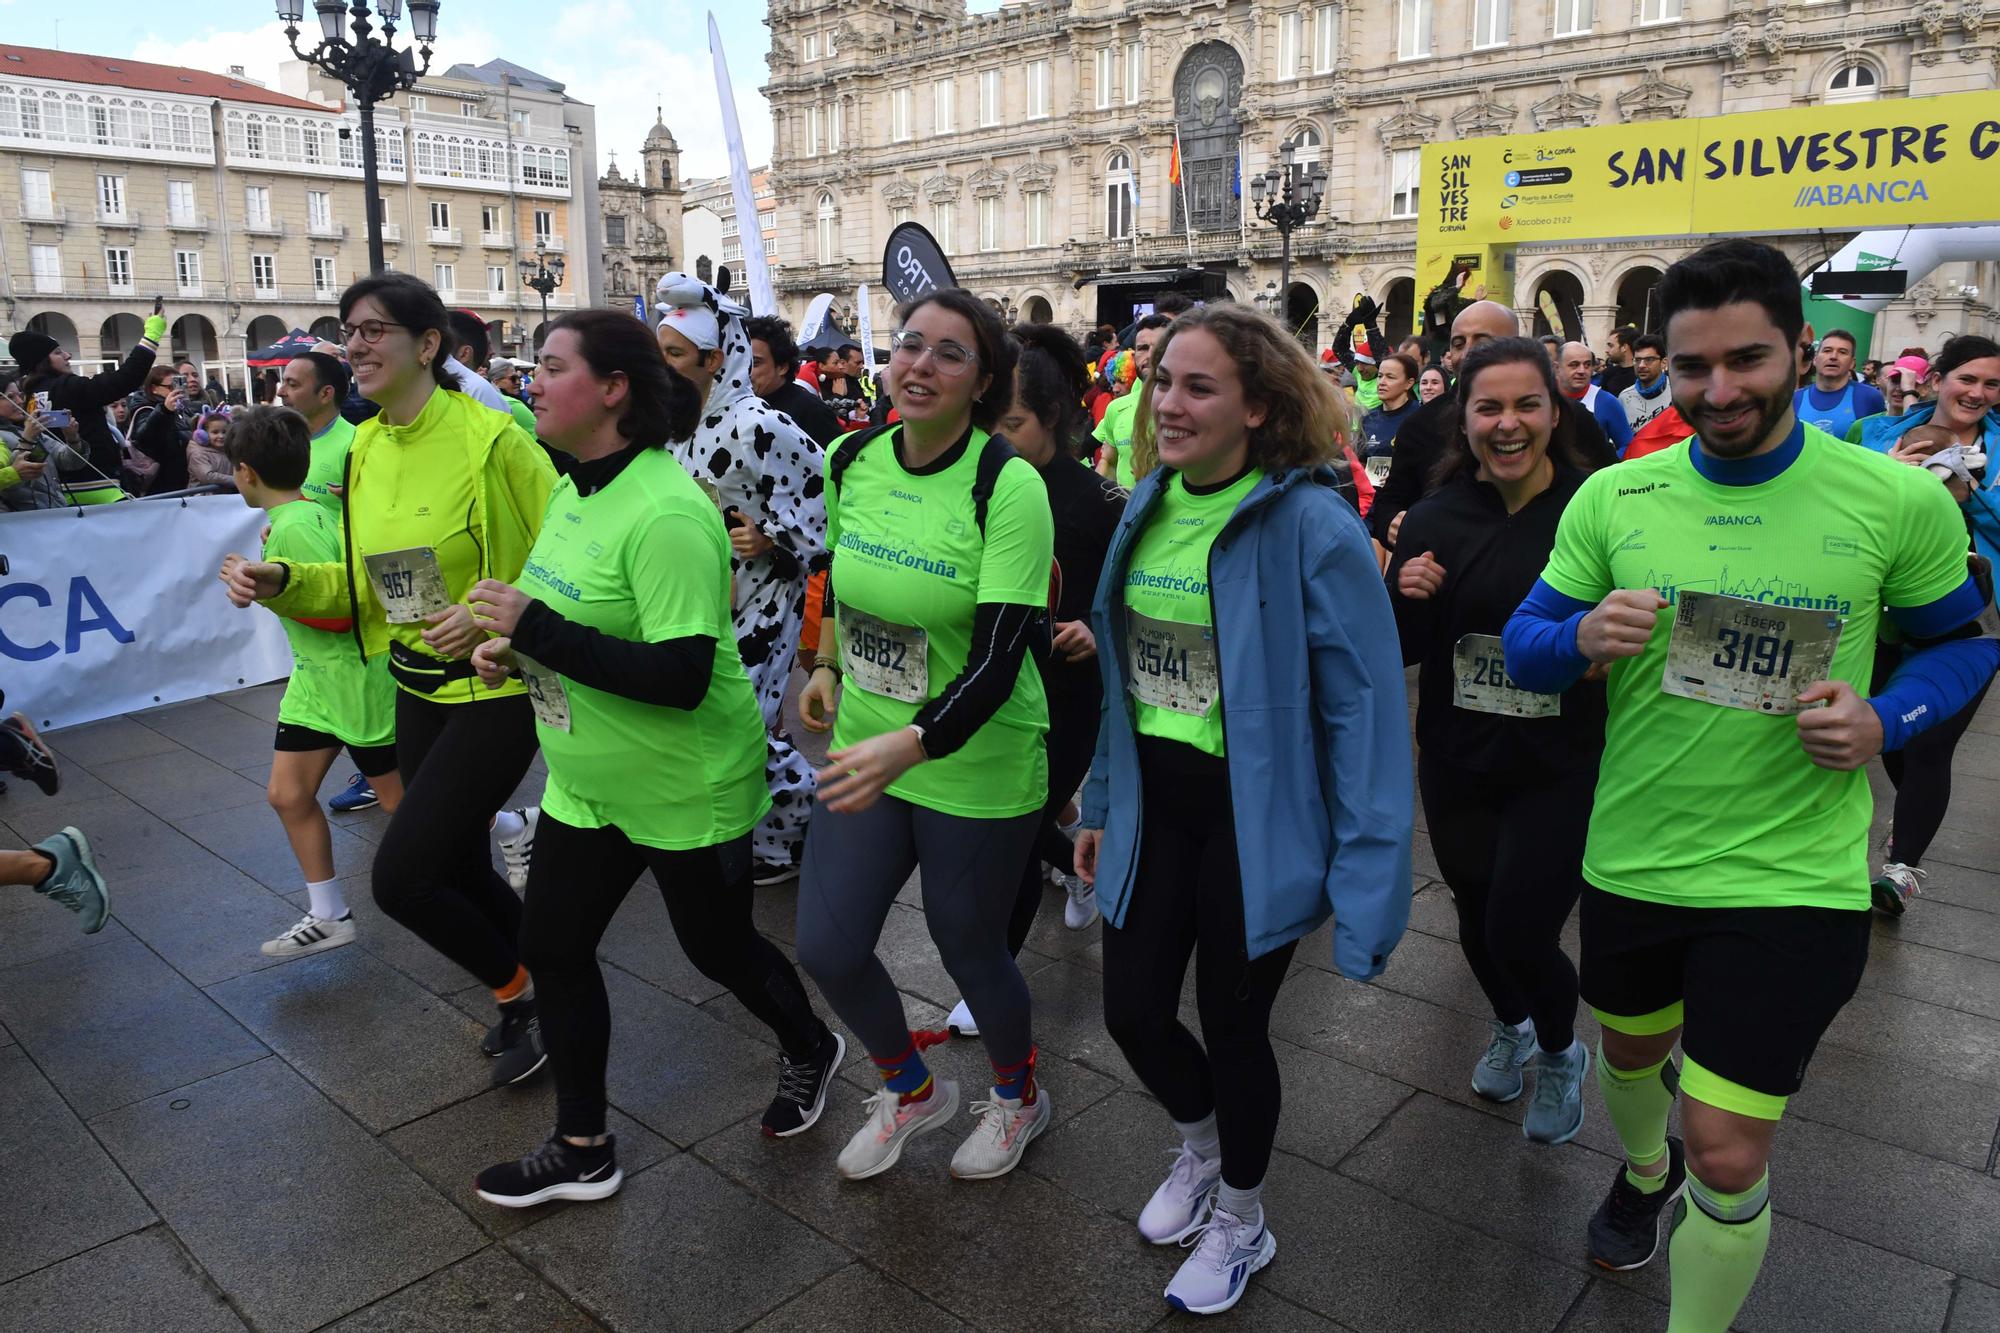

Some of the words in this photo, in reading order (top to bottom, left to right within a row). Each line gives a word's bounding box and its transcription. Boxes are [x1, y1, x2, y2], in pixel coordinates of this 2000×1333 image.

[1442, 154, 1471, 171] SAN
[1608, 147, 1686, 188] SAN
[1704, 124, 1949, 180] SILVESTRE
[1441, 171, 1470, 190] SIL
[1440, 190, 1469, 206] VES
[1440, 206, 1468, 223] TRE
[1618, 482, 1655, 496] luanvi
[382, 570, 413, 600] 967
[1733, 614, 1786, 632] LIBERO
[850, 627, 907, 673] 3682
[1713, 628, 1794, 679] 3191
[1137, 638, 1188, 682] 3541
[1901, 704, 1928, 723] kipsta
